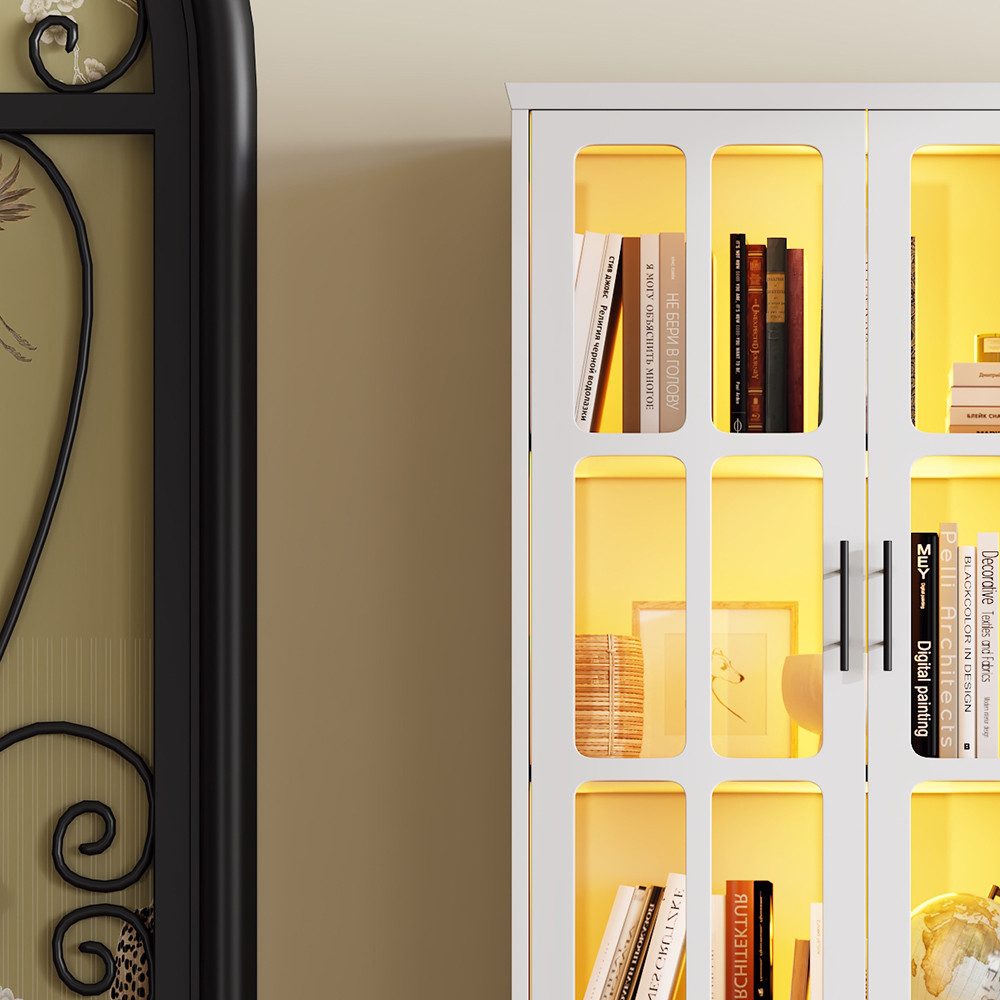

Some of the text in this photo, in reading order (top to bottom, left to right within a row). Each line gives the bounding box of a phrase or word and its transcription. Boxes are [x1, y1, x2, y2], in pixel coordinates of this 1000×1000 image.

[646, 273, 654, 300] МОГУ
[666, 293, 679, 308] НЕ
[595, 305, 607, 340] Религия
[646, 304, 654, 364] ОБЪЯСНИТЬ
[666, 313, 679, 345] БЕРИ
[589, 342, 600, 373] черной
[581, 375, 595, 421] водолазки
[646, 368, 654, 410] МНОГОЕ
[666, 360, 679, 410] ГОЛОВУ
[964, 556, 972, 712] BLACKCOLOR IN DESIGN
[981, 550, 999, 682] Decorative Textiles and Fabrics
[940, 531, 957, 748] Pelli Architects
[914, 640, 931, 737] Digital painting
